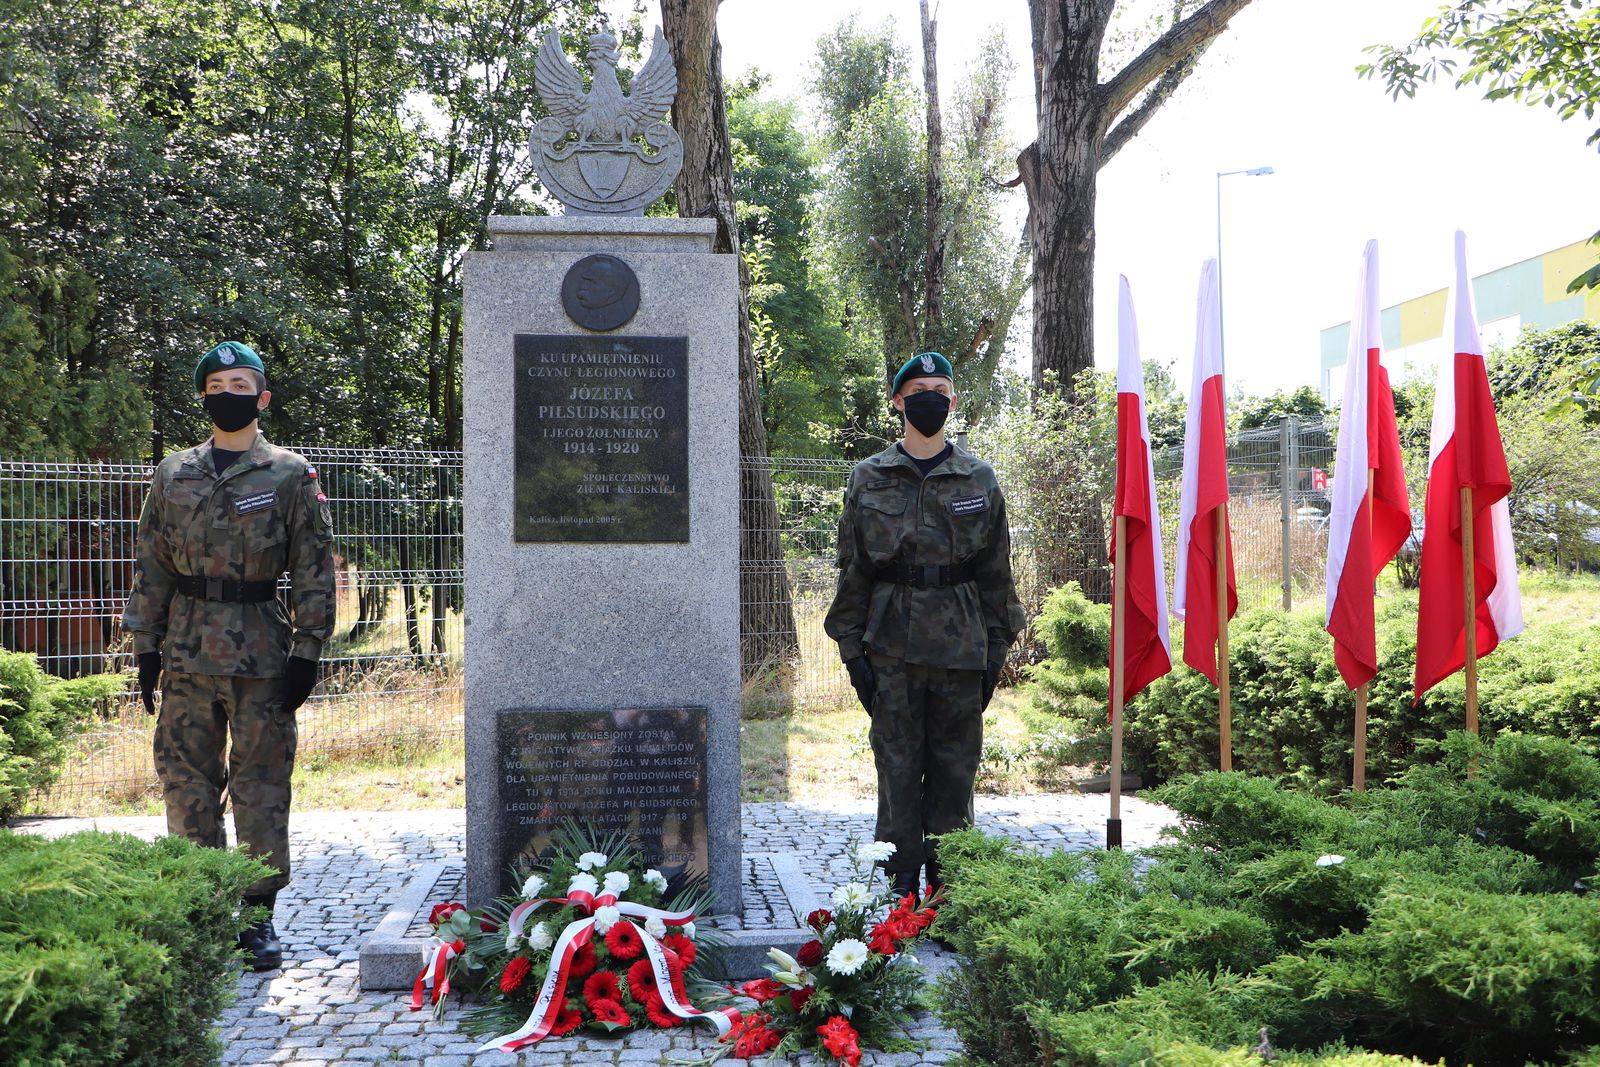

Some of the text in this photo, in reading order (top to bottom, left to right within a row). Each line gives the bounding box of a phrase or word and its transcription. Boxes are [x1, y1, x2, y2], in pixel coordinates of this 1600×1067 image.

[541, 353, 664, 366] KU UPAMIĘTNIENIU
[528, 367, 676, 378] CZYNU LEGIONOWEGO
[569, 384, 634, 400] JÓZEFA
[538, 405, 666, 419] PIŁSUDSKIEGO
[550, 428, 584, 438] JEGO
[586, 426, 661, 439] ŻOŁNIERZY
[563, 442, 595, 453] 1914
[606, 442, 640, 453] 1920
[576, 484, 676, 494] ZIEMI KALISKIEJ
[560, 515, 593, 527] listopad
[528, 730, 677, 741] POMNIK WZNIESIONY ZOSTAŁ
[511, 747, 519, 756] Z
[505, 760, 569, 769] WOJENNYCH
[574, 760, 588, 768] RP
[592, 759, 635, 768] ODDZIAŁ
[640, 758, 649, 766] W
[506, 775, 526, 783] DLA
[613, 771, 699, 780] POBUDOWANEGO
[526, 788, 539, 796] TU
[543, 788, 553, 796] W
[584, 787, 612, 795] ROKU
[617, 785, 680, 794] MAUZOLEUM
[519, 816, 573, 825] ZMARŁYC
[592, 814, 631, 823] LATACH
